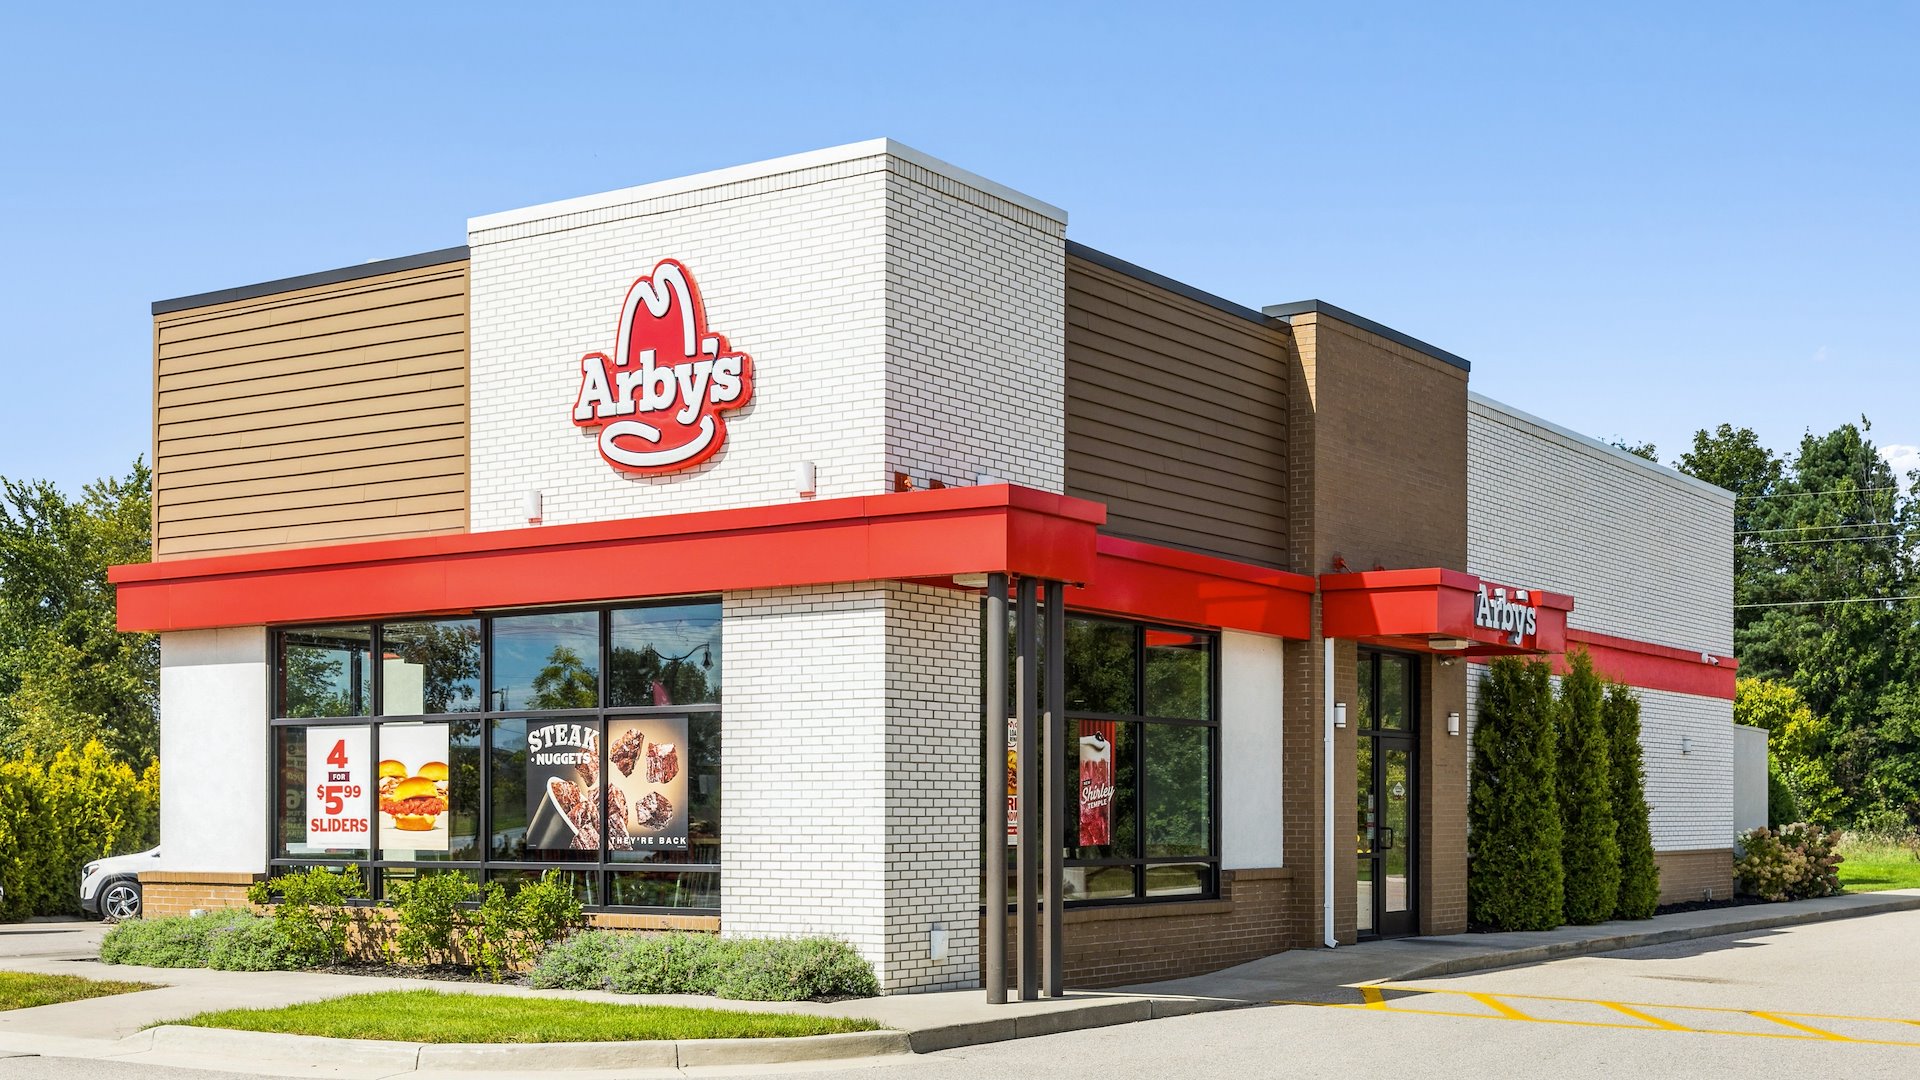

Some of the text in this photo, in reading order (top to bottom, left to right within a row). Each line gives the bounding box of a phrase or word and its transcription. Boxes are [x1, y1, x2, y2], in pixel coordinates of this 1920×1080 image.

[574, 337, 744, 425] Arby's
[1476, 583, 1536, 645] Arby's
[527, 724, 600, 753] STEAK
[326, 739, 348, 768] 4
[536, 752, 591, 765] NUGGETS
[1080, 783, 1115, 804] Shirley
[1087, 799, 1107, 809] TEMPLE
[311, 818, 368, 832] SLIDERS
[610, 836, 687, 844] THEY'RE BACK
